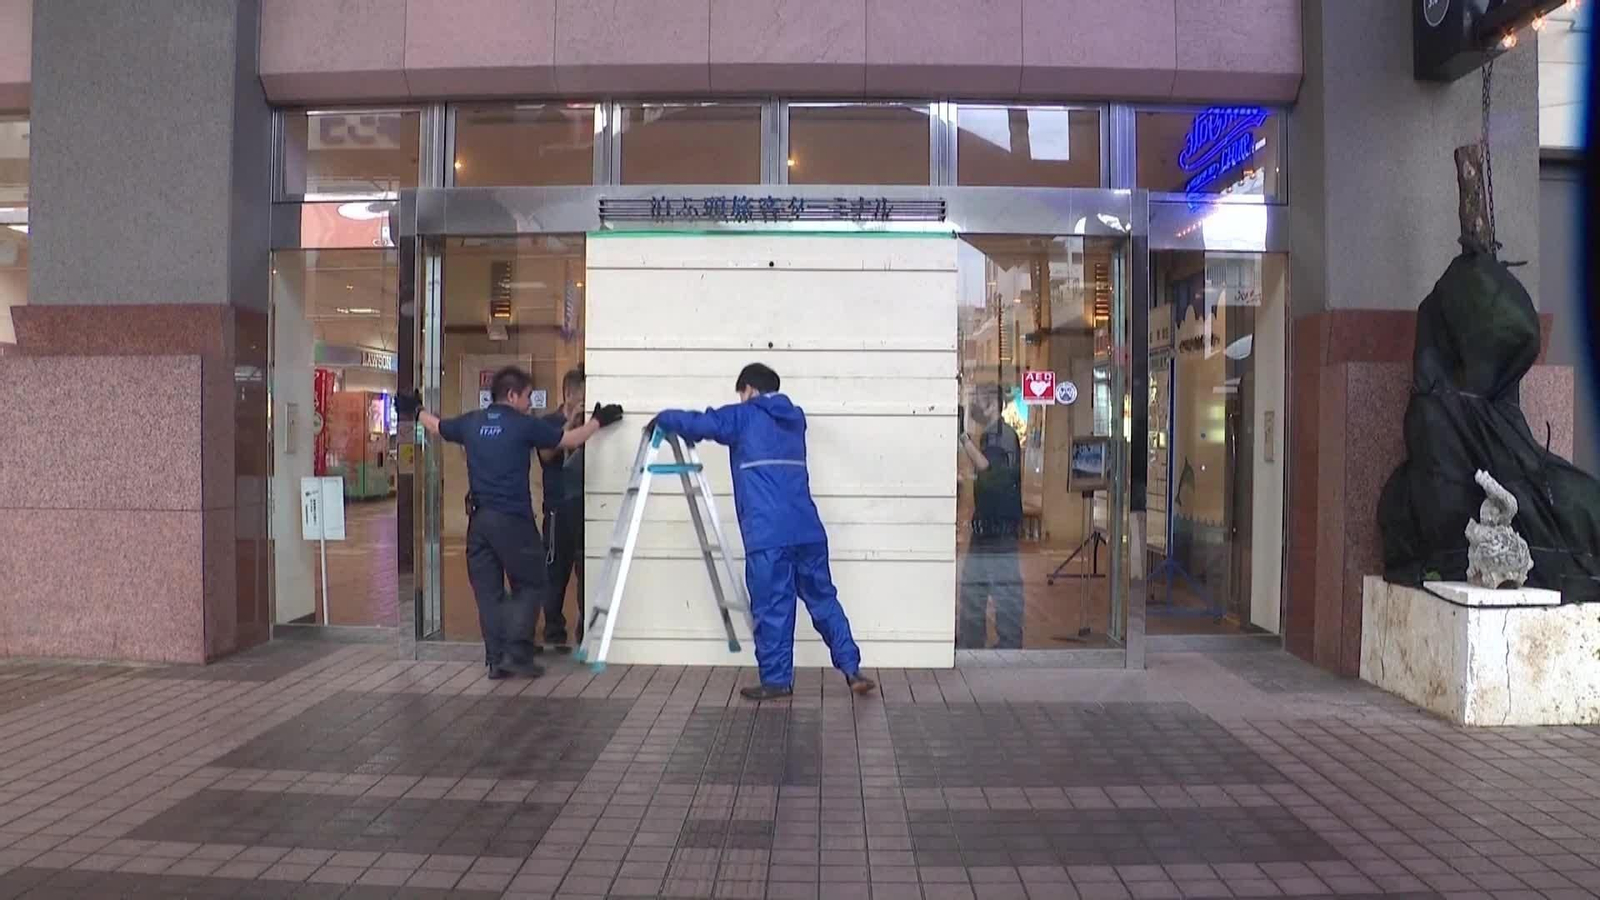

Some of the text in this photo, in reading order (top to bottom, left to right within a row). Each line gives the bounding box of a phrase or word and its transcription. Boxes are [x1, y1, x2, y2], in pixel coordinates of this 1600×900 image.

[362, 352, 392, 370] LAWSON
[1025, 372, 1052, 381] AED
[480, 427, 502, 436] STAFF
